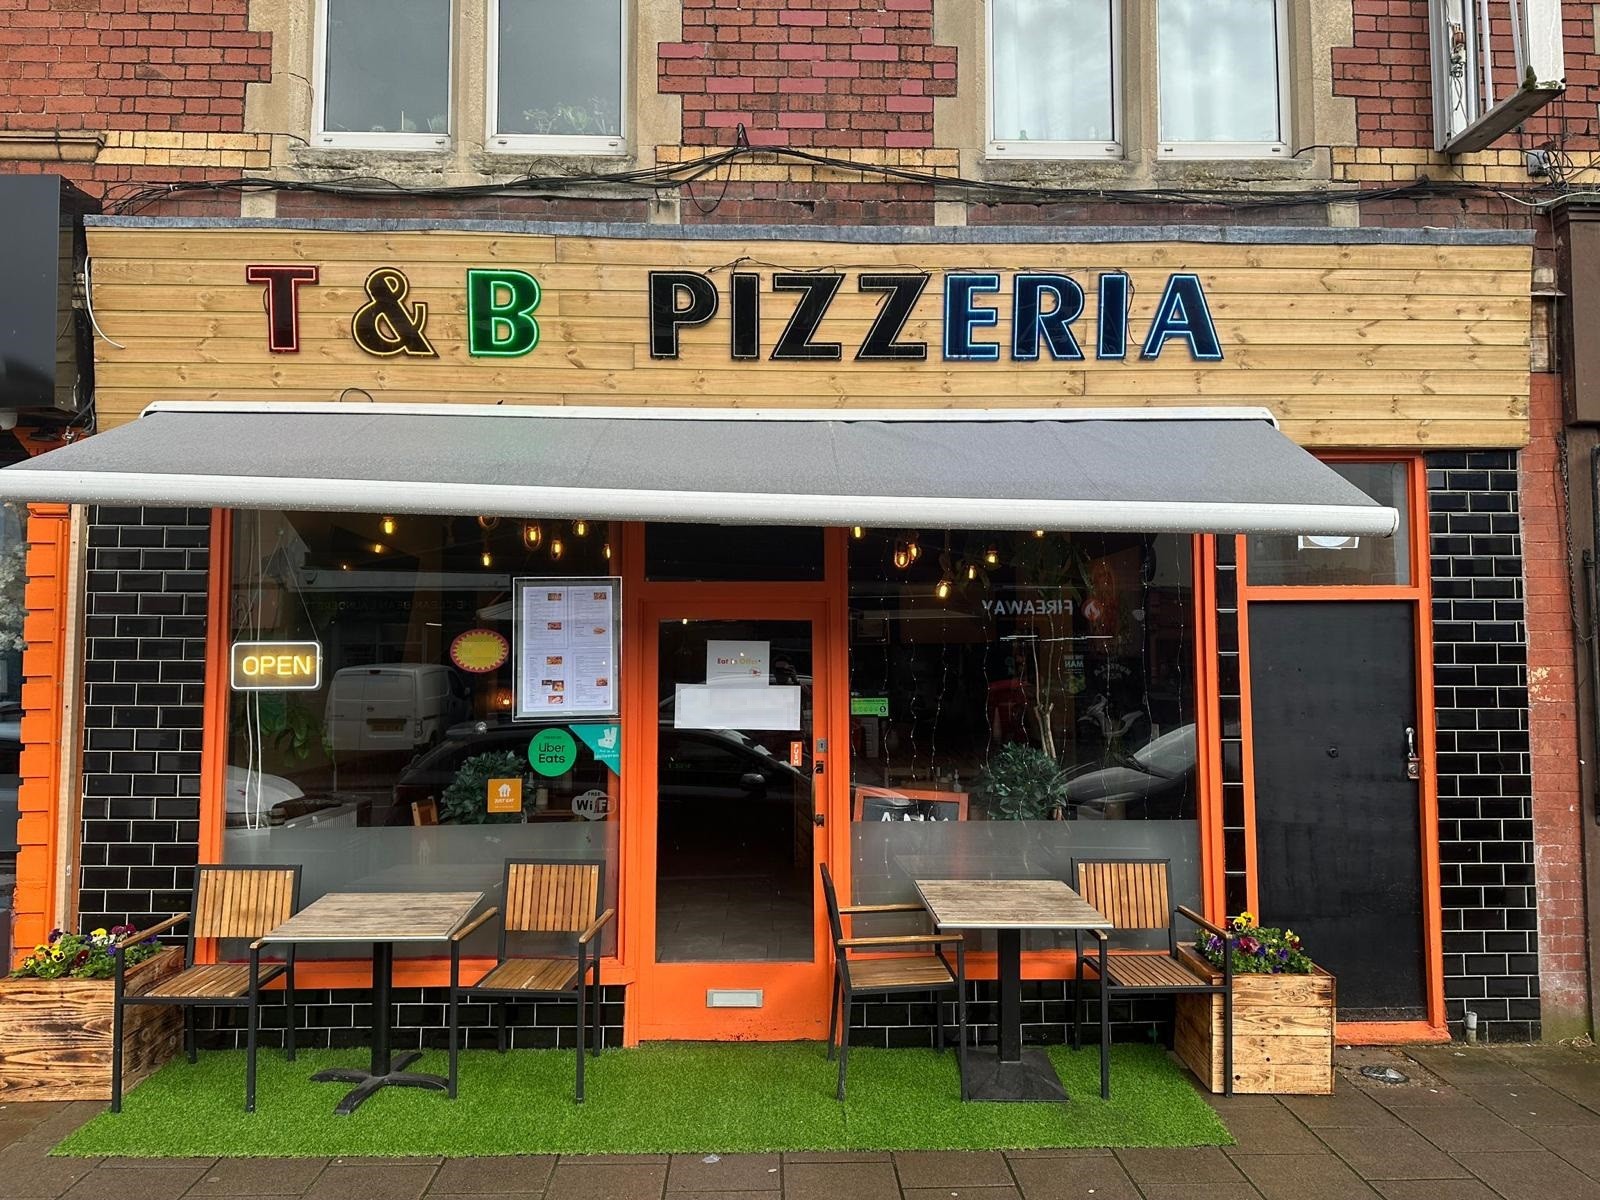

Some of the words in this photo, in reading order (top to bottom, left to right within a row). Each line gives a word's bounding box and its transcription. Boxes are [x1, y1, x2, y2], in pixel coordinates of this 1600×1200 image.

[246, 265, 319, 353] T
[351, 267, 440, 358] &
[467, 268, 541, 359] B
[649, 270, 1224, 361] PIZZERIA
[241, 655, 312, 677] OPEN
[538, 742, 566, 753] Uber
[538, 754, 566, 764] Eats
